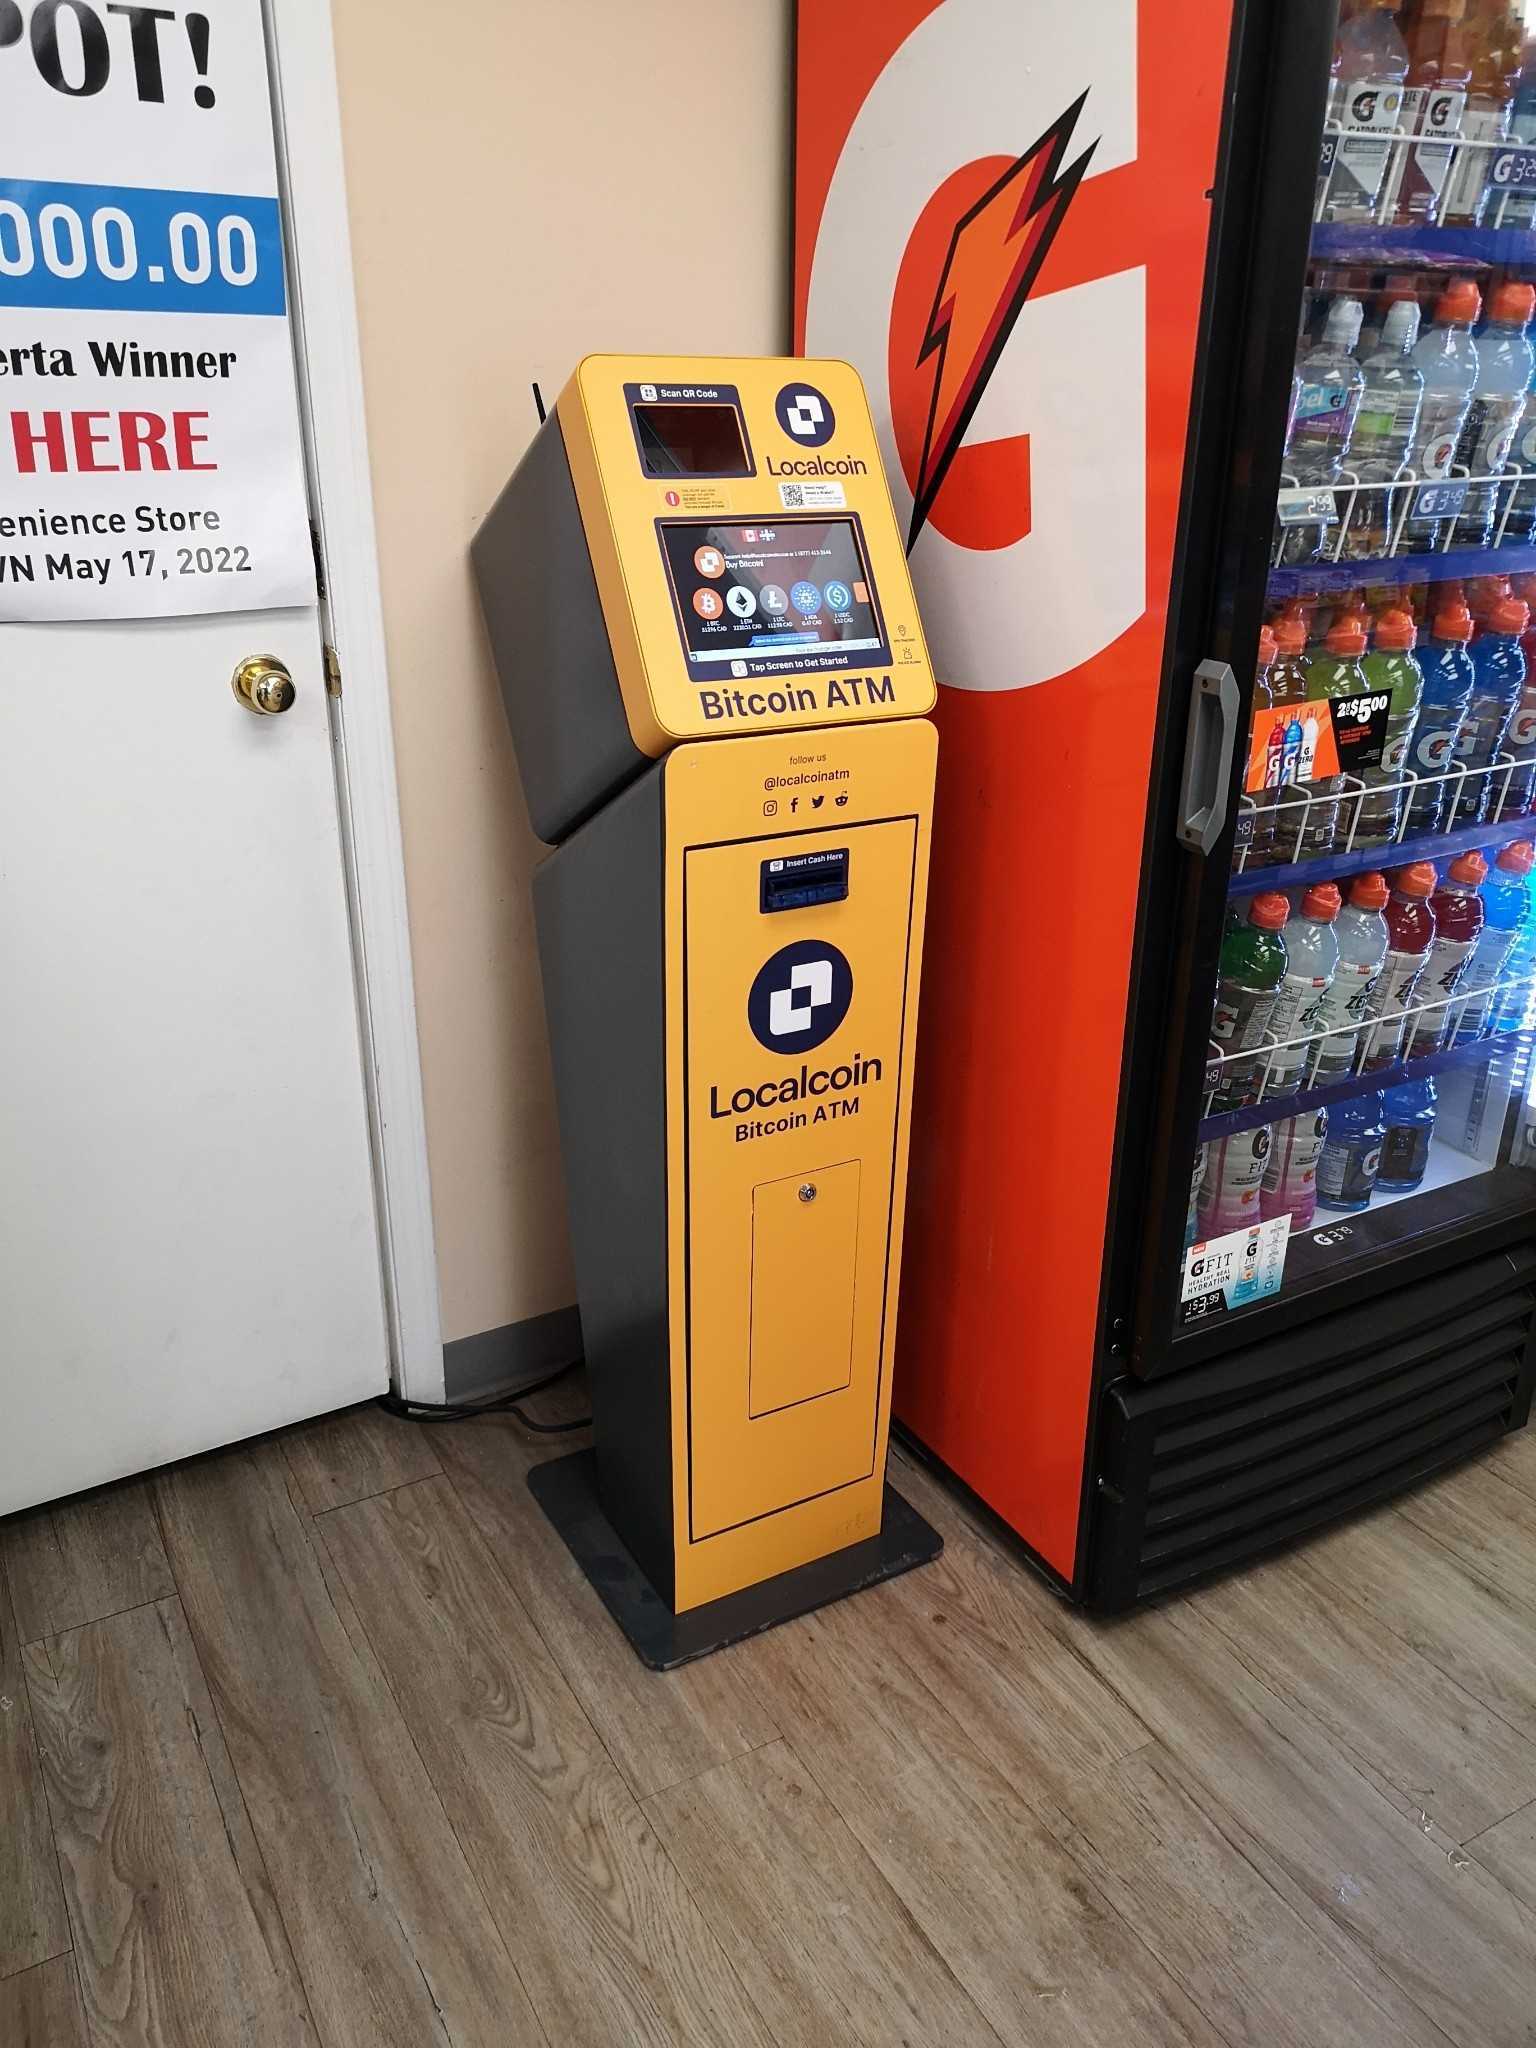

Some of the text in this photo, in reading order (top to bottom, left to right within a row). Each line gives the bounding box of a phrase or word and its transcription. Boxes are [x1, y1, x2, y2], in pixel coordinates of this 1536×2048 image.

[88, 341, 237, 378] Winner
[660, 388, 718, 398] Scan QR Code
[10, 411, 218, 473] HERE
[766, 454, 868, 477] Localcoin
[0, 506, 221, 537] enience Store
[45, 552, 111, 585] May
[122, 549, 169, 580] 17,
[176, 545, 252, 575] 2022
[750, 656, 848, 672] Tap Screen to Get Started
[700, 675, 896, 720] Bitcoin ATM
[789, 753, 827, 766] follow us
[764, 769, 850, 791] @localcoinatm
[786, 852, 844, 868] Insert Cash Here
[710, 1053, 882, 1119] Localcoin
[735, 1096, 860, 1143] Bitcoin ATM
[1187, 1274, 1231, 1295] HYDRATION
